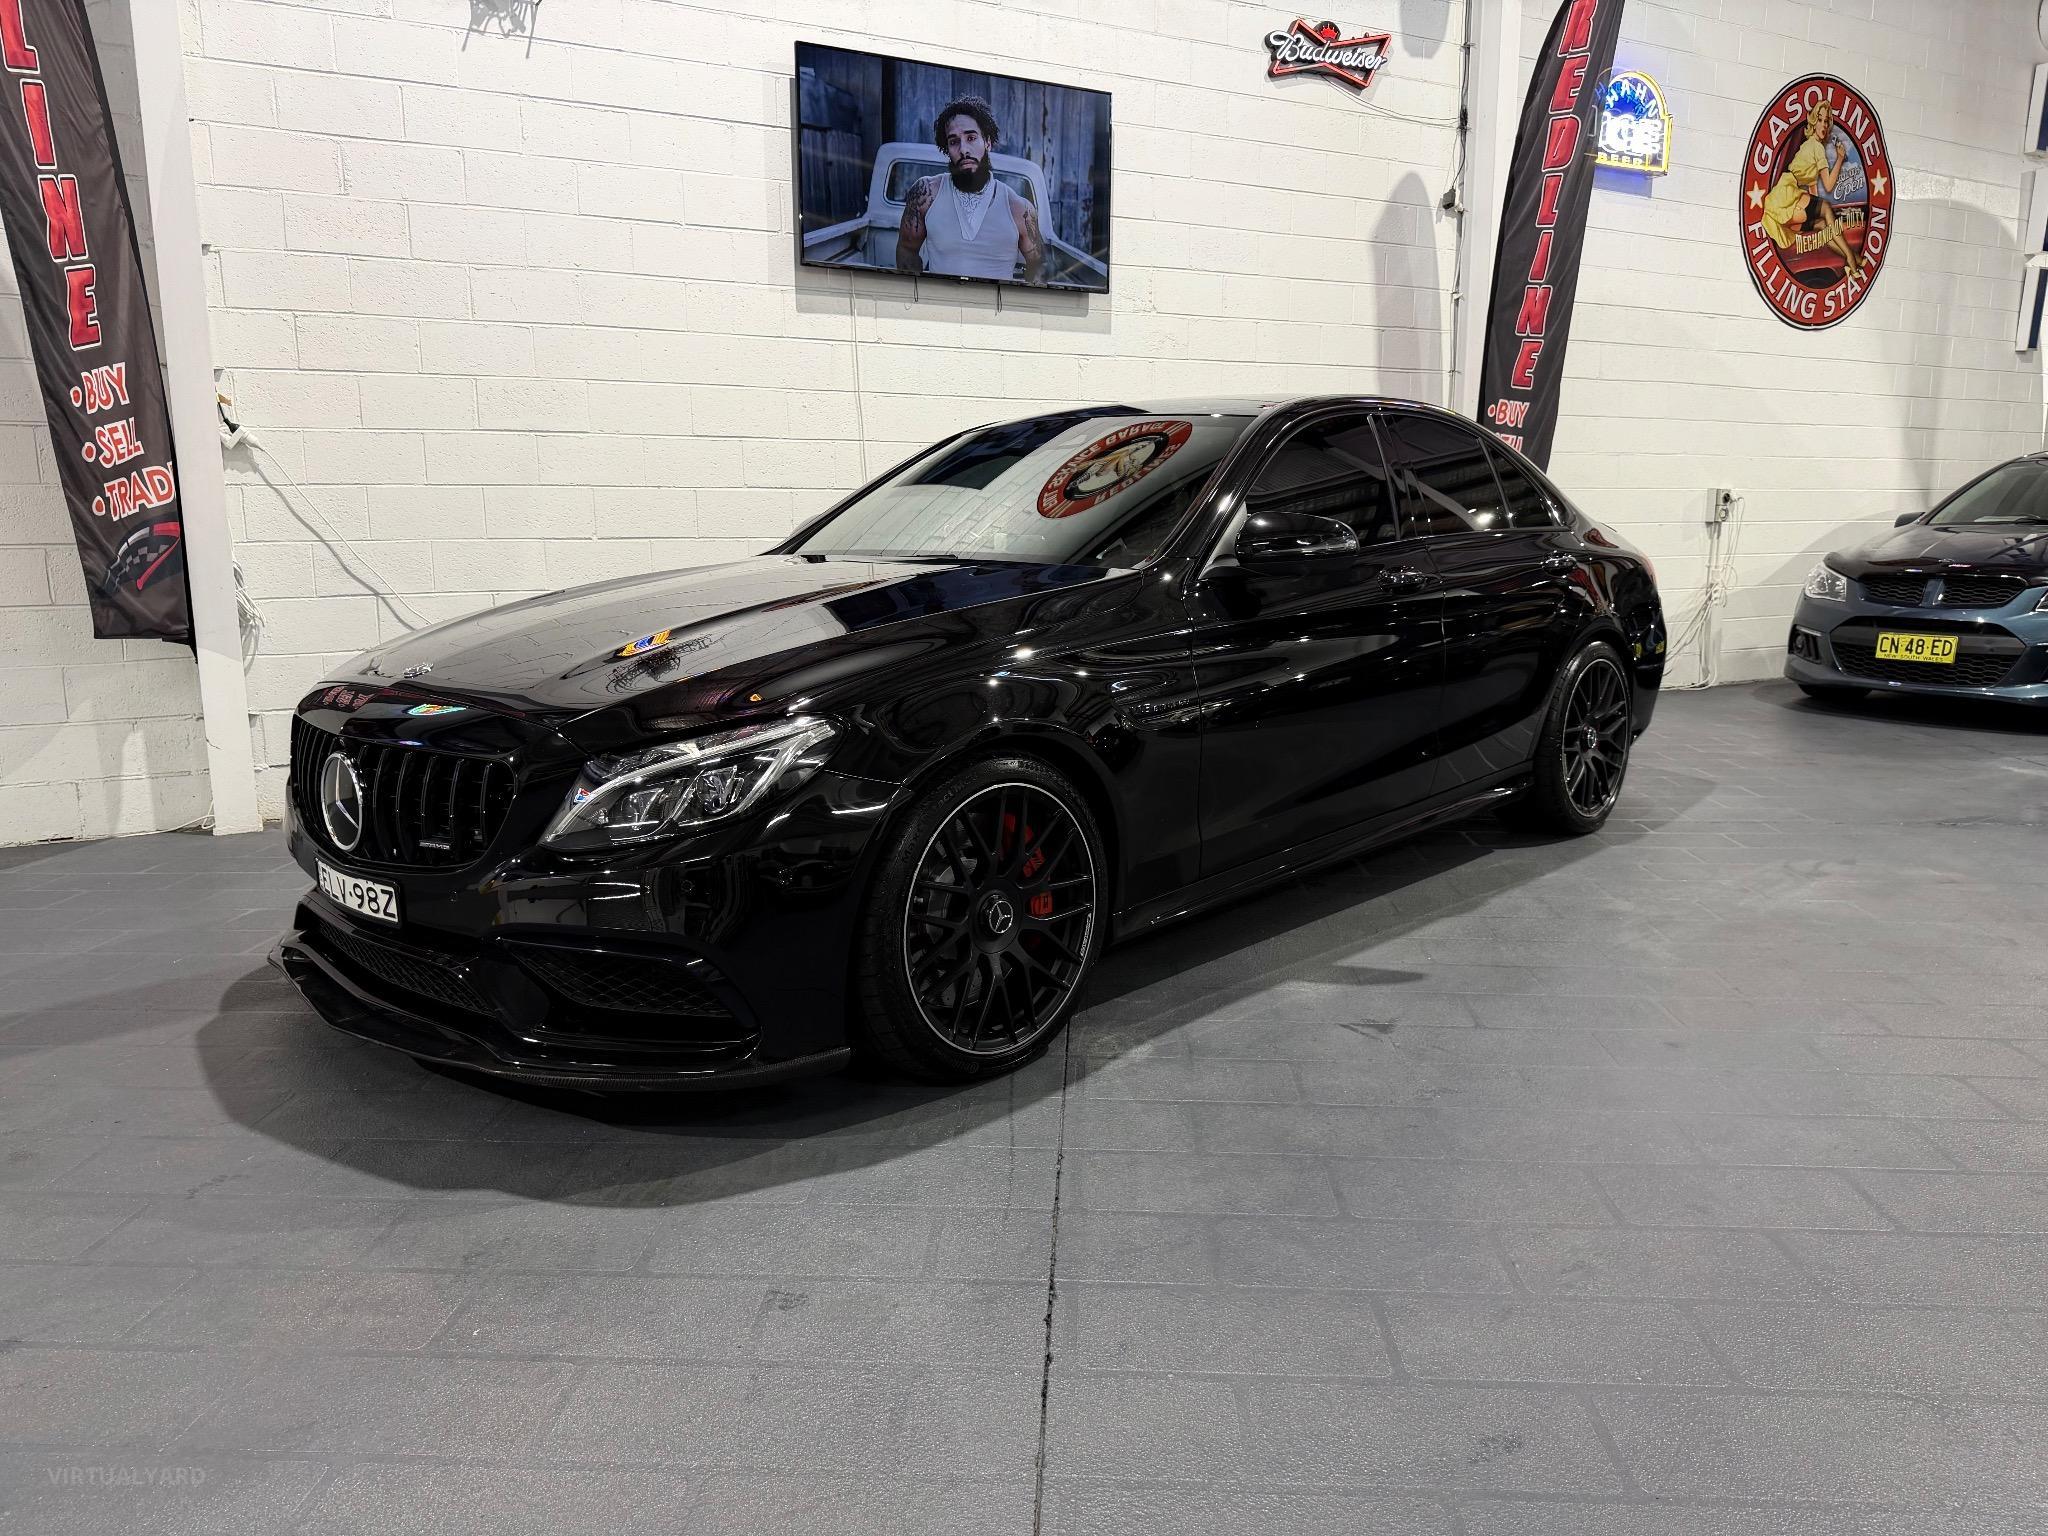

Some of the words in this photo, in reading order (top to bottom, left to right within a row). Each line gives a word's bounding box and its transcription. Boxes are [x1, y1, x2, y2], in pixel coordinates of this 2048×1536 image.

[1269, 31, 1387, 70] Budweiser
[1753, 85, 1881, 174] GASOLINE
[1511, 0, 1598, 390] REDLINE
[1833, 177, 1864, 201] Open
[1748, 221, 1817, 319] FILLING
[81, 362, 130, 415] BUY
[1495, 399, 1530, 429] BUY
[94, 417, 143, 469] SELL
[105, 461, 176, 521] TRAD
